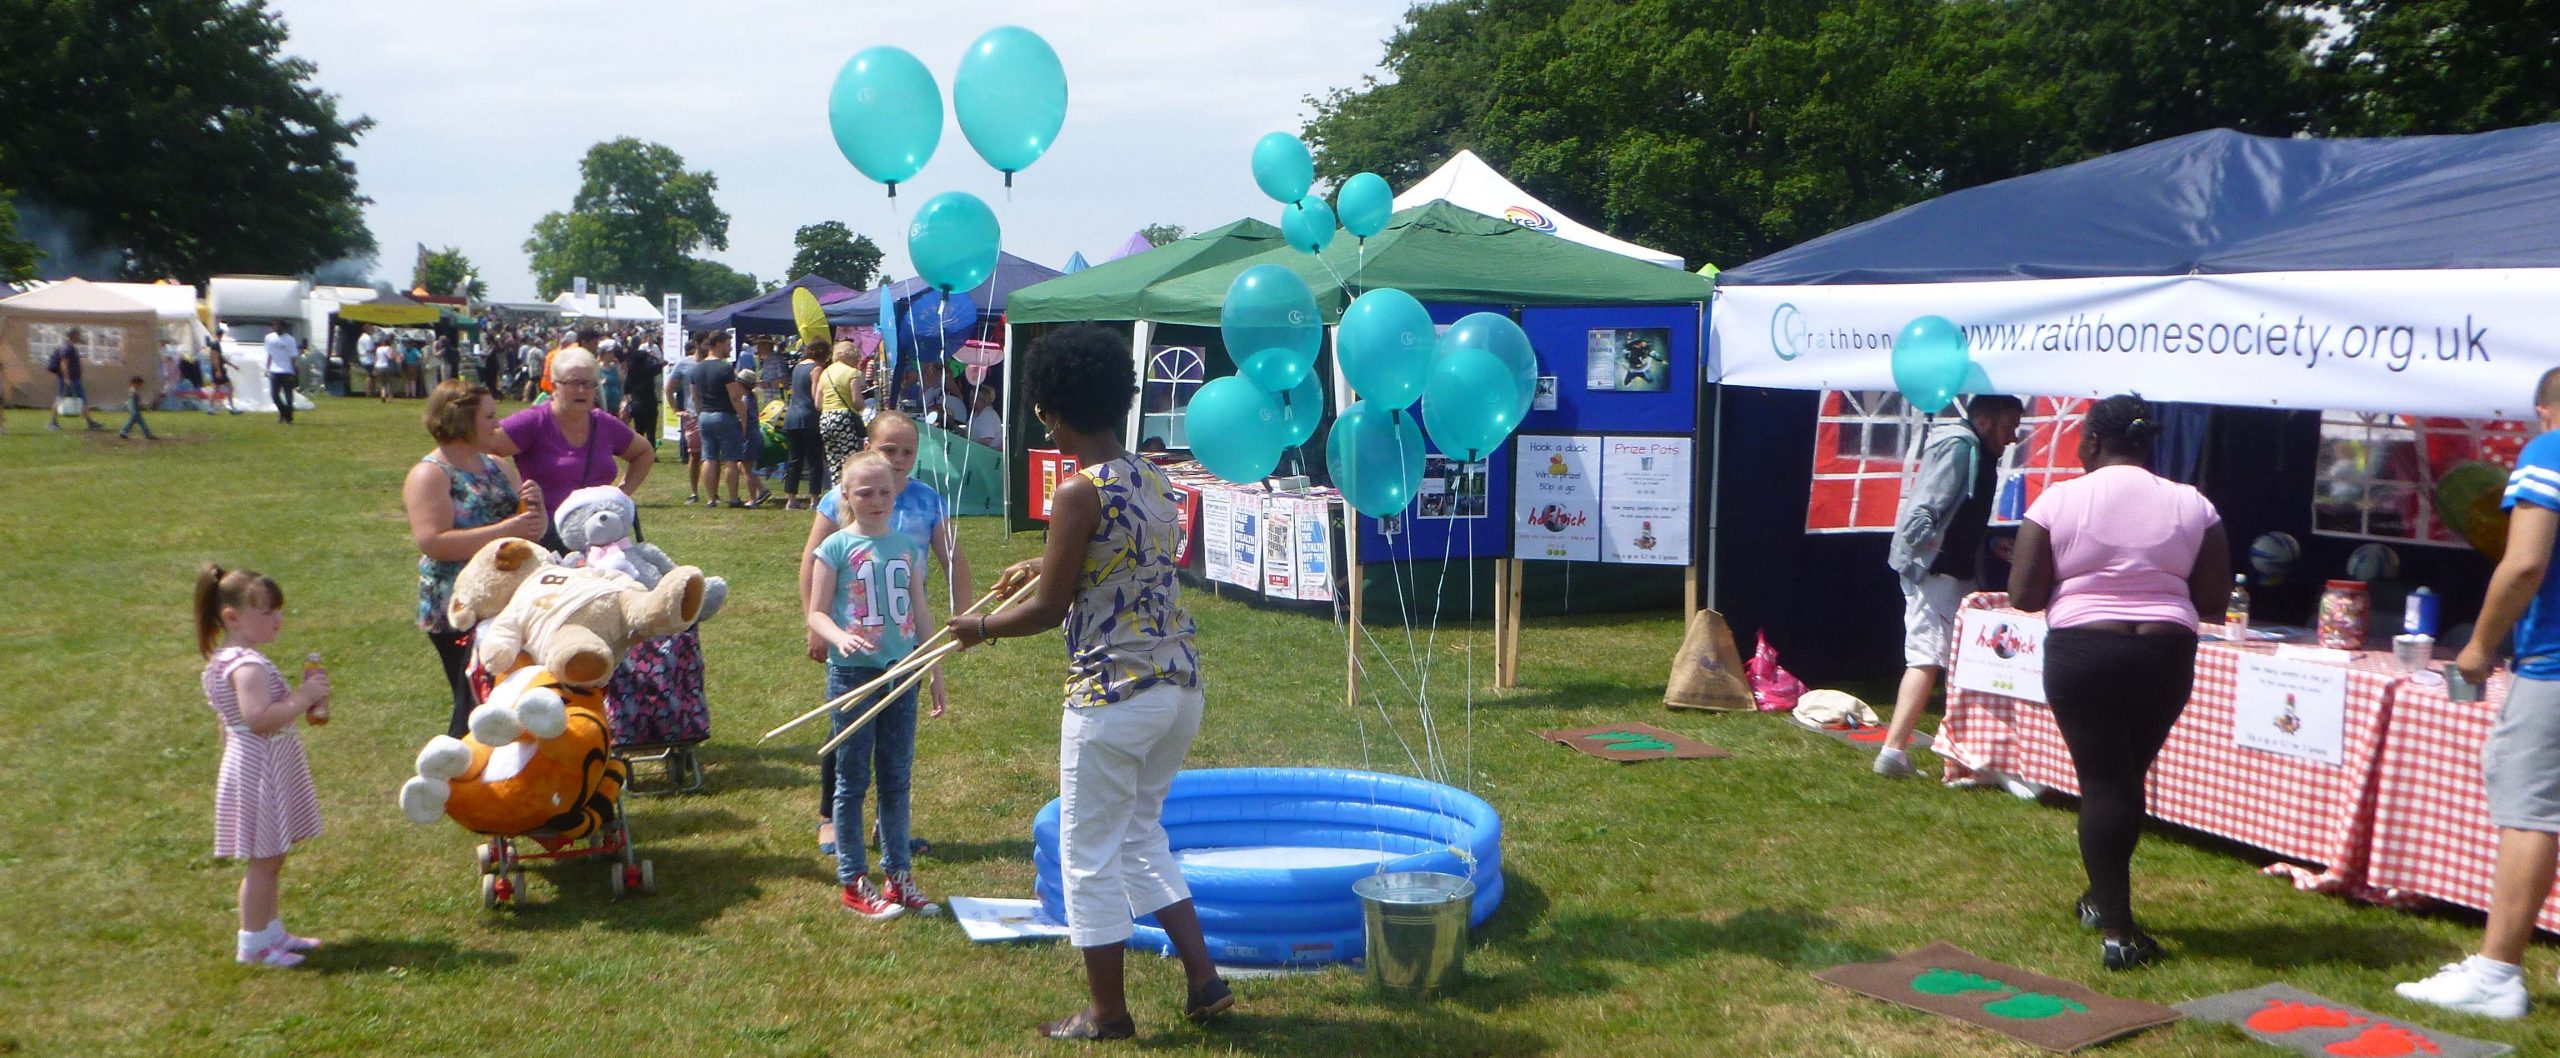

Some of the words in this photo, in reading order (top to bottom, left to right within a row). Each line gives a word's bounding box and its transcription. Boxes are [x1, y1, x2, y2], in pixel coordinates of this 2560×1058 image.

[1807, 328, 1898, 350] rathbon
[1530, 442, 1552, 452] Hook
[1565, 443, 1588, 453] duck
[1614, 443, 1646, 455] Prize
[1650, 443, 1680, 455] Pots
[856, 558, 912, 626] 16
